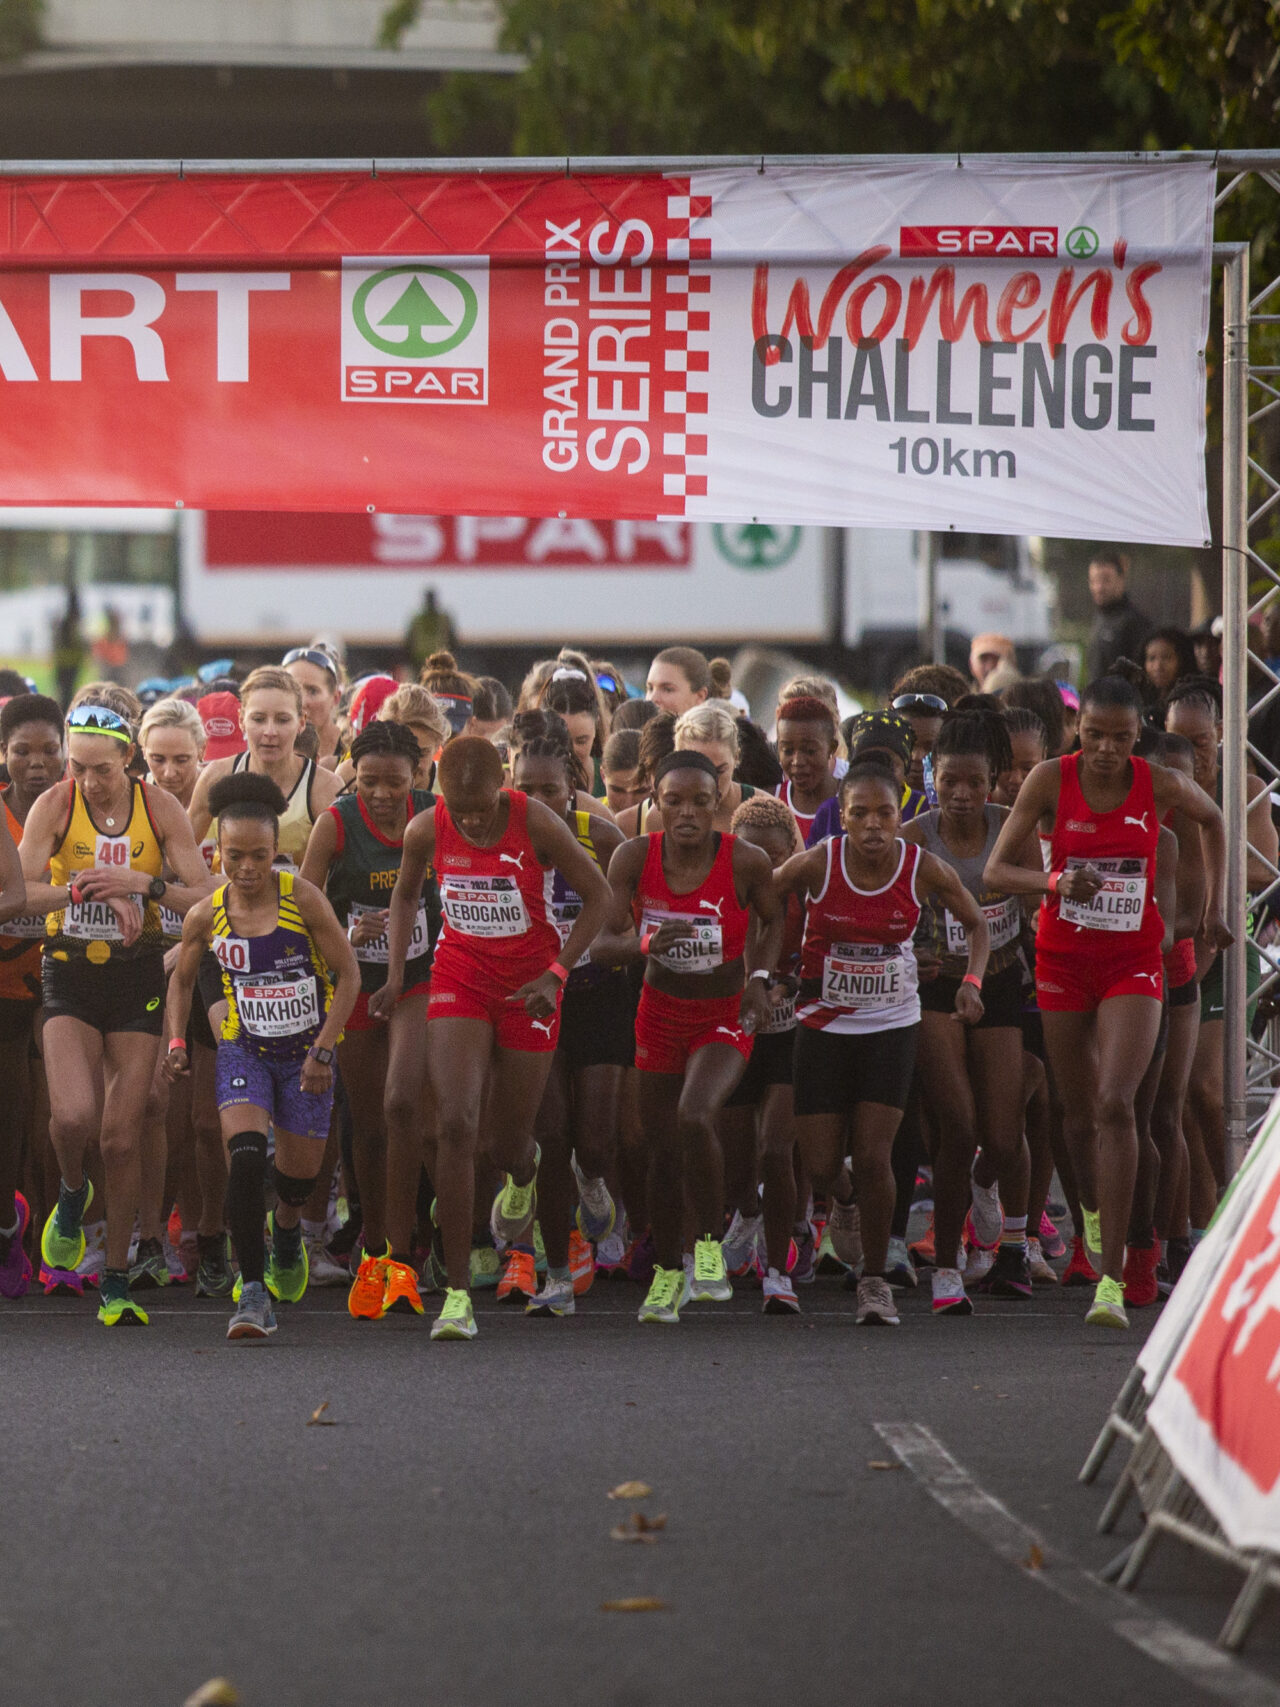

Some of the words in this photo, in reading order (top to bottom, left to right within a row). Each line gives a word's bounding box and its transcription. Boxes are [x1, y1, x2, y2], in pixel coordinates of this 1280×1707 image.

[936, 229, 1058, 255] SPAR
[545, 218, 582, 317] PRIX
[751, 238, 1163, 367] Women's
[586, 217, 654, 477] SERIES
[349, 370, 481, 398] SPAR
[751, 333, 1157, 432] CHALLENGE
[543, 325, 581, 474] GRAND
[889, 437, 1018, 480] 10km
[373, 514, 687, 563] SPAR
[98, 842, 127, 866] 40
[1098, 862, 1117, 872] 2022
[458, 893, 498, 902] SPAR
[471, 880, 490, 890] 2022
[71, 901, 116, 925] CHAR
[444, 902, 521, 923] LEBOGANG
[1107, 897, 1142, 914] LEBO
[216, 941, 246, 970] 40
[843, 965, 884, 973] SPAR
[254, 988, 295, 998] SPAR
[827, 971, 900, 995] ZANDILE
[241, 993, 316, 1021] MAKHOSI
